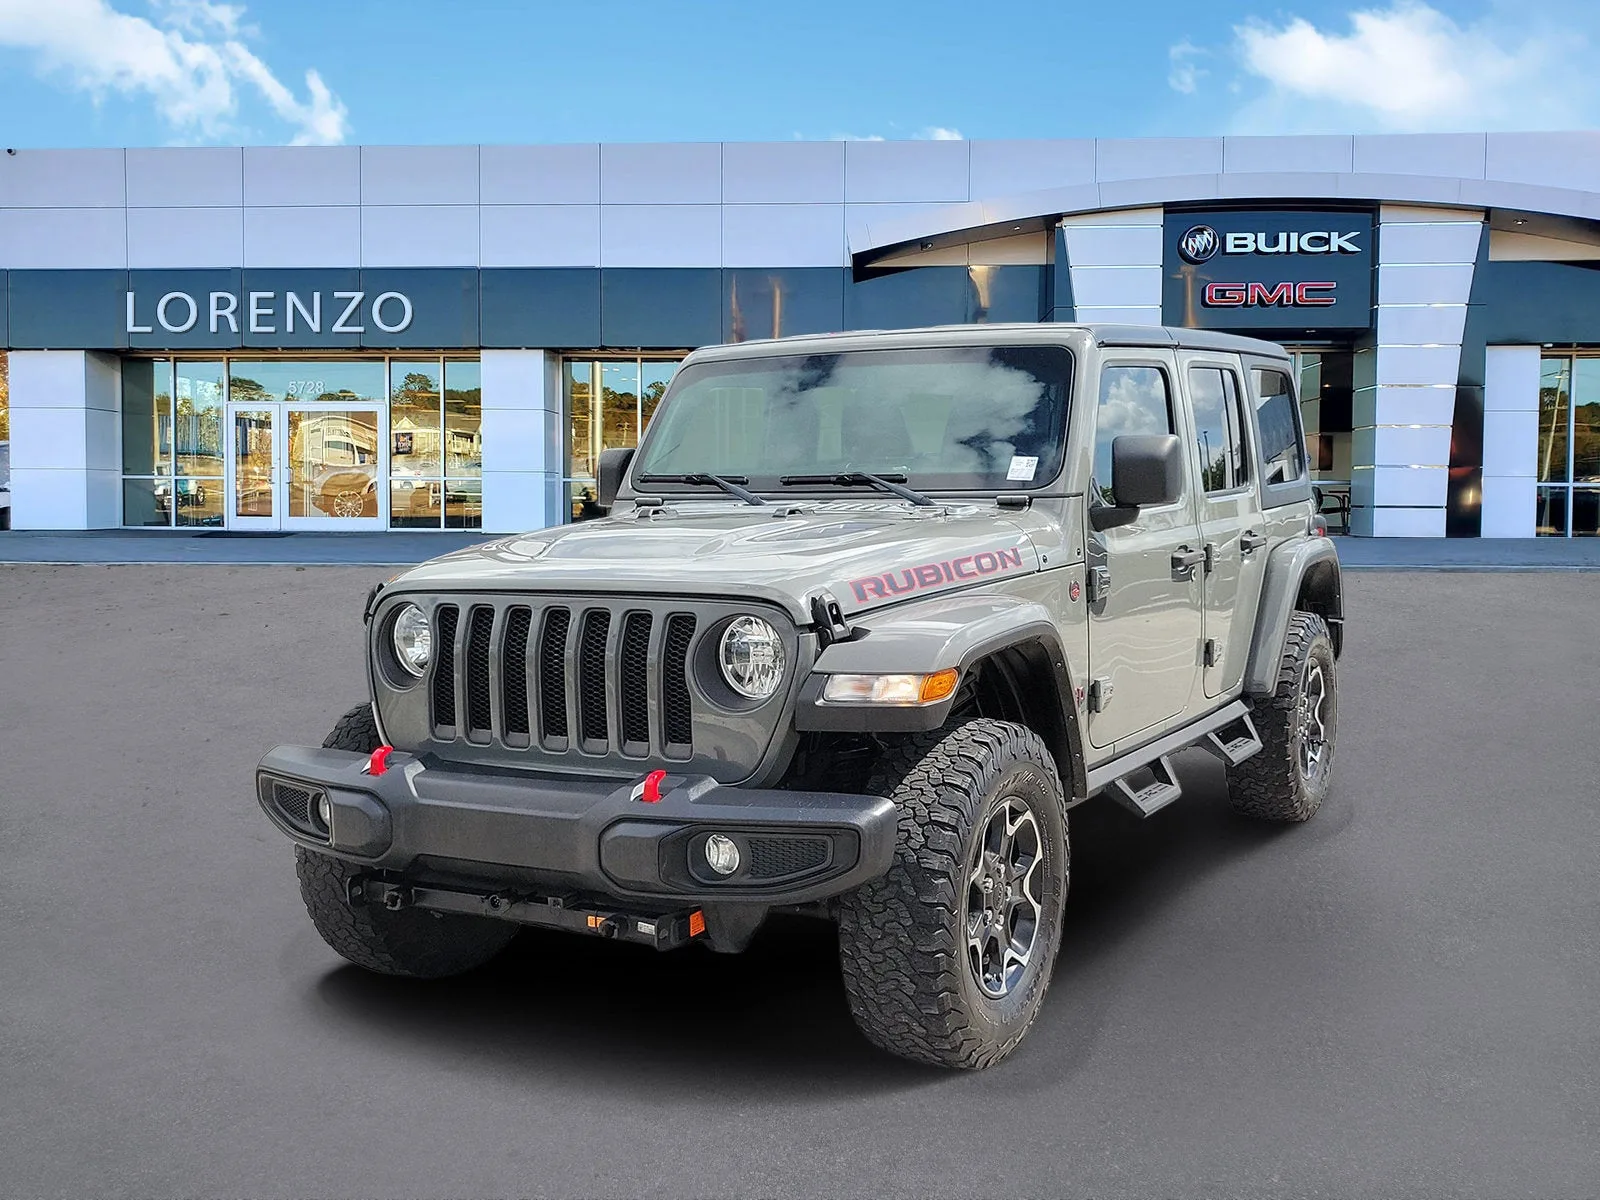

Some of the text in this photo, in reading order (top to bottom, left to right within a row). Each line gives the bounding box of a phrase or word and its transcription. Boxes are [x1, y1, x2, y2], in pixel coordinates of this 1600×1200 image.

[1225, 231, 1362, 253] BUICK
[1205, 281, 1337, 305] GMC
[126, 291, 414, 333] LORENZO
[288, 380, 325, 394] 5728
[849, 547, 1023, 604] RUBICON
